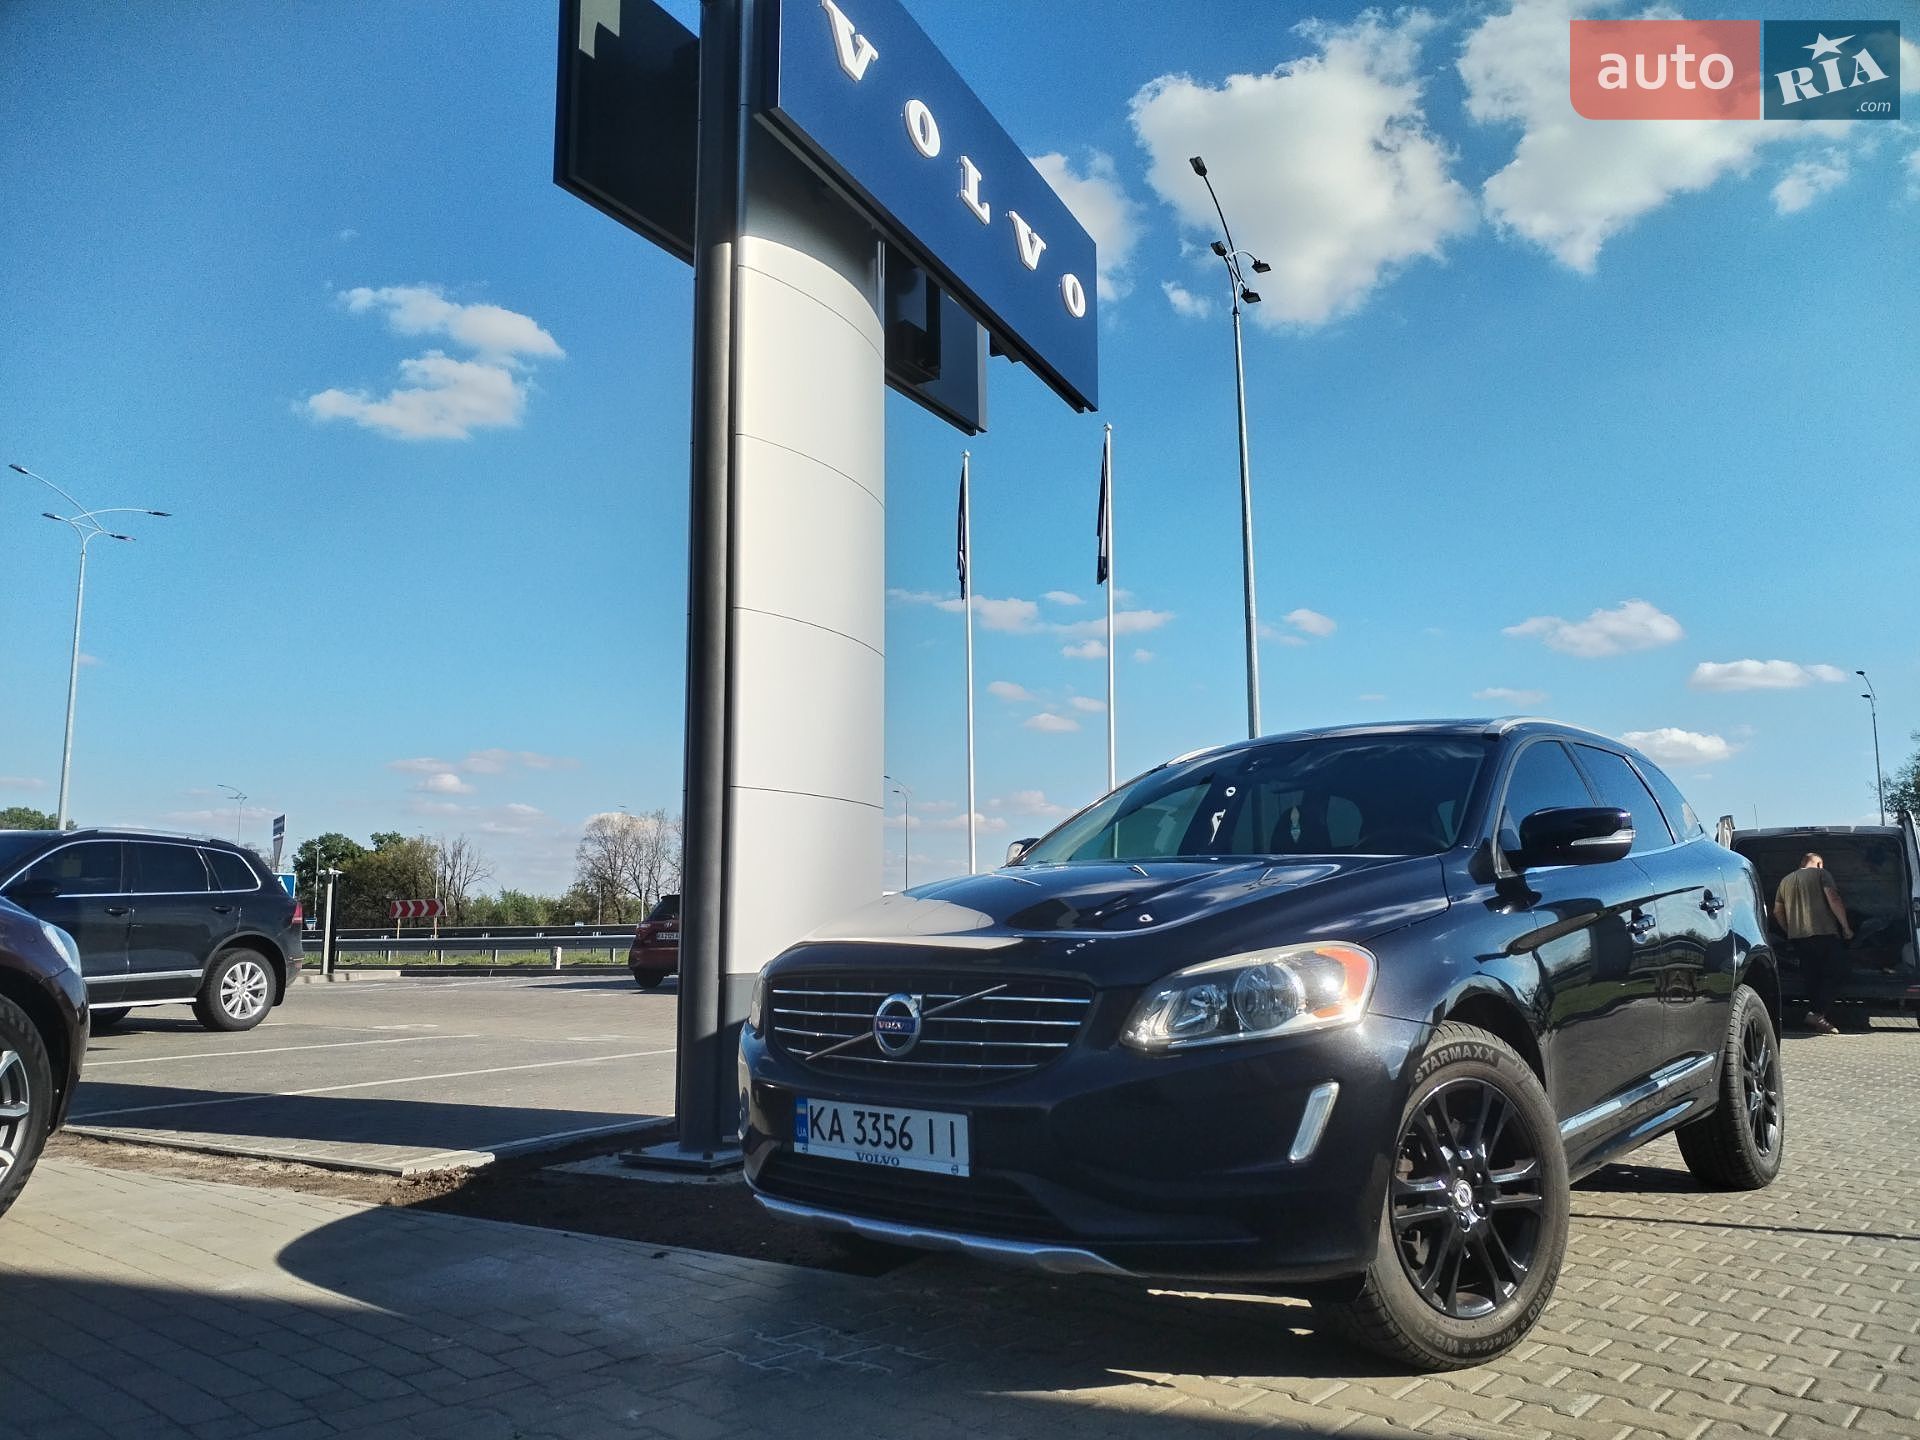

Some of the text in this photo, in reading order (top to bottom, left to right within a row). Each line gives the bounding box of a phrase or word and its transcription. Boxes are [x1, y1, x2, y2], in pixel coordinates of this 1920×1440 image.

[821, 0, 1086, 318] VOLVO
[1414, 1044, 1496, 1083] STARMAXX
[810, 1105, 845, 1143] KA
[853, 1110, 913, 1151] 3356
[856, 1152, 900, 1166] VOLVO
